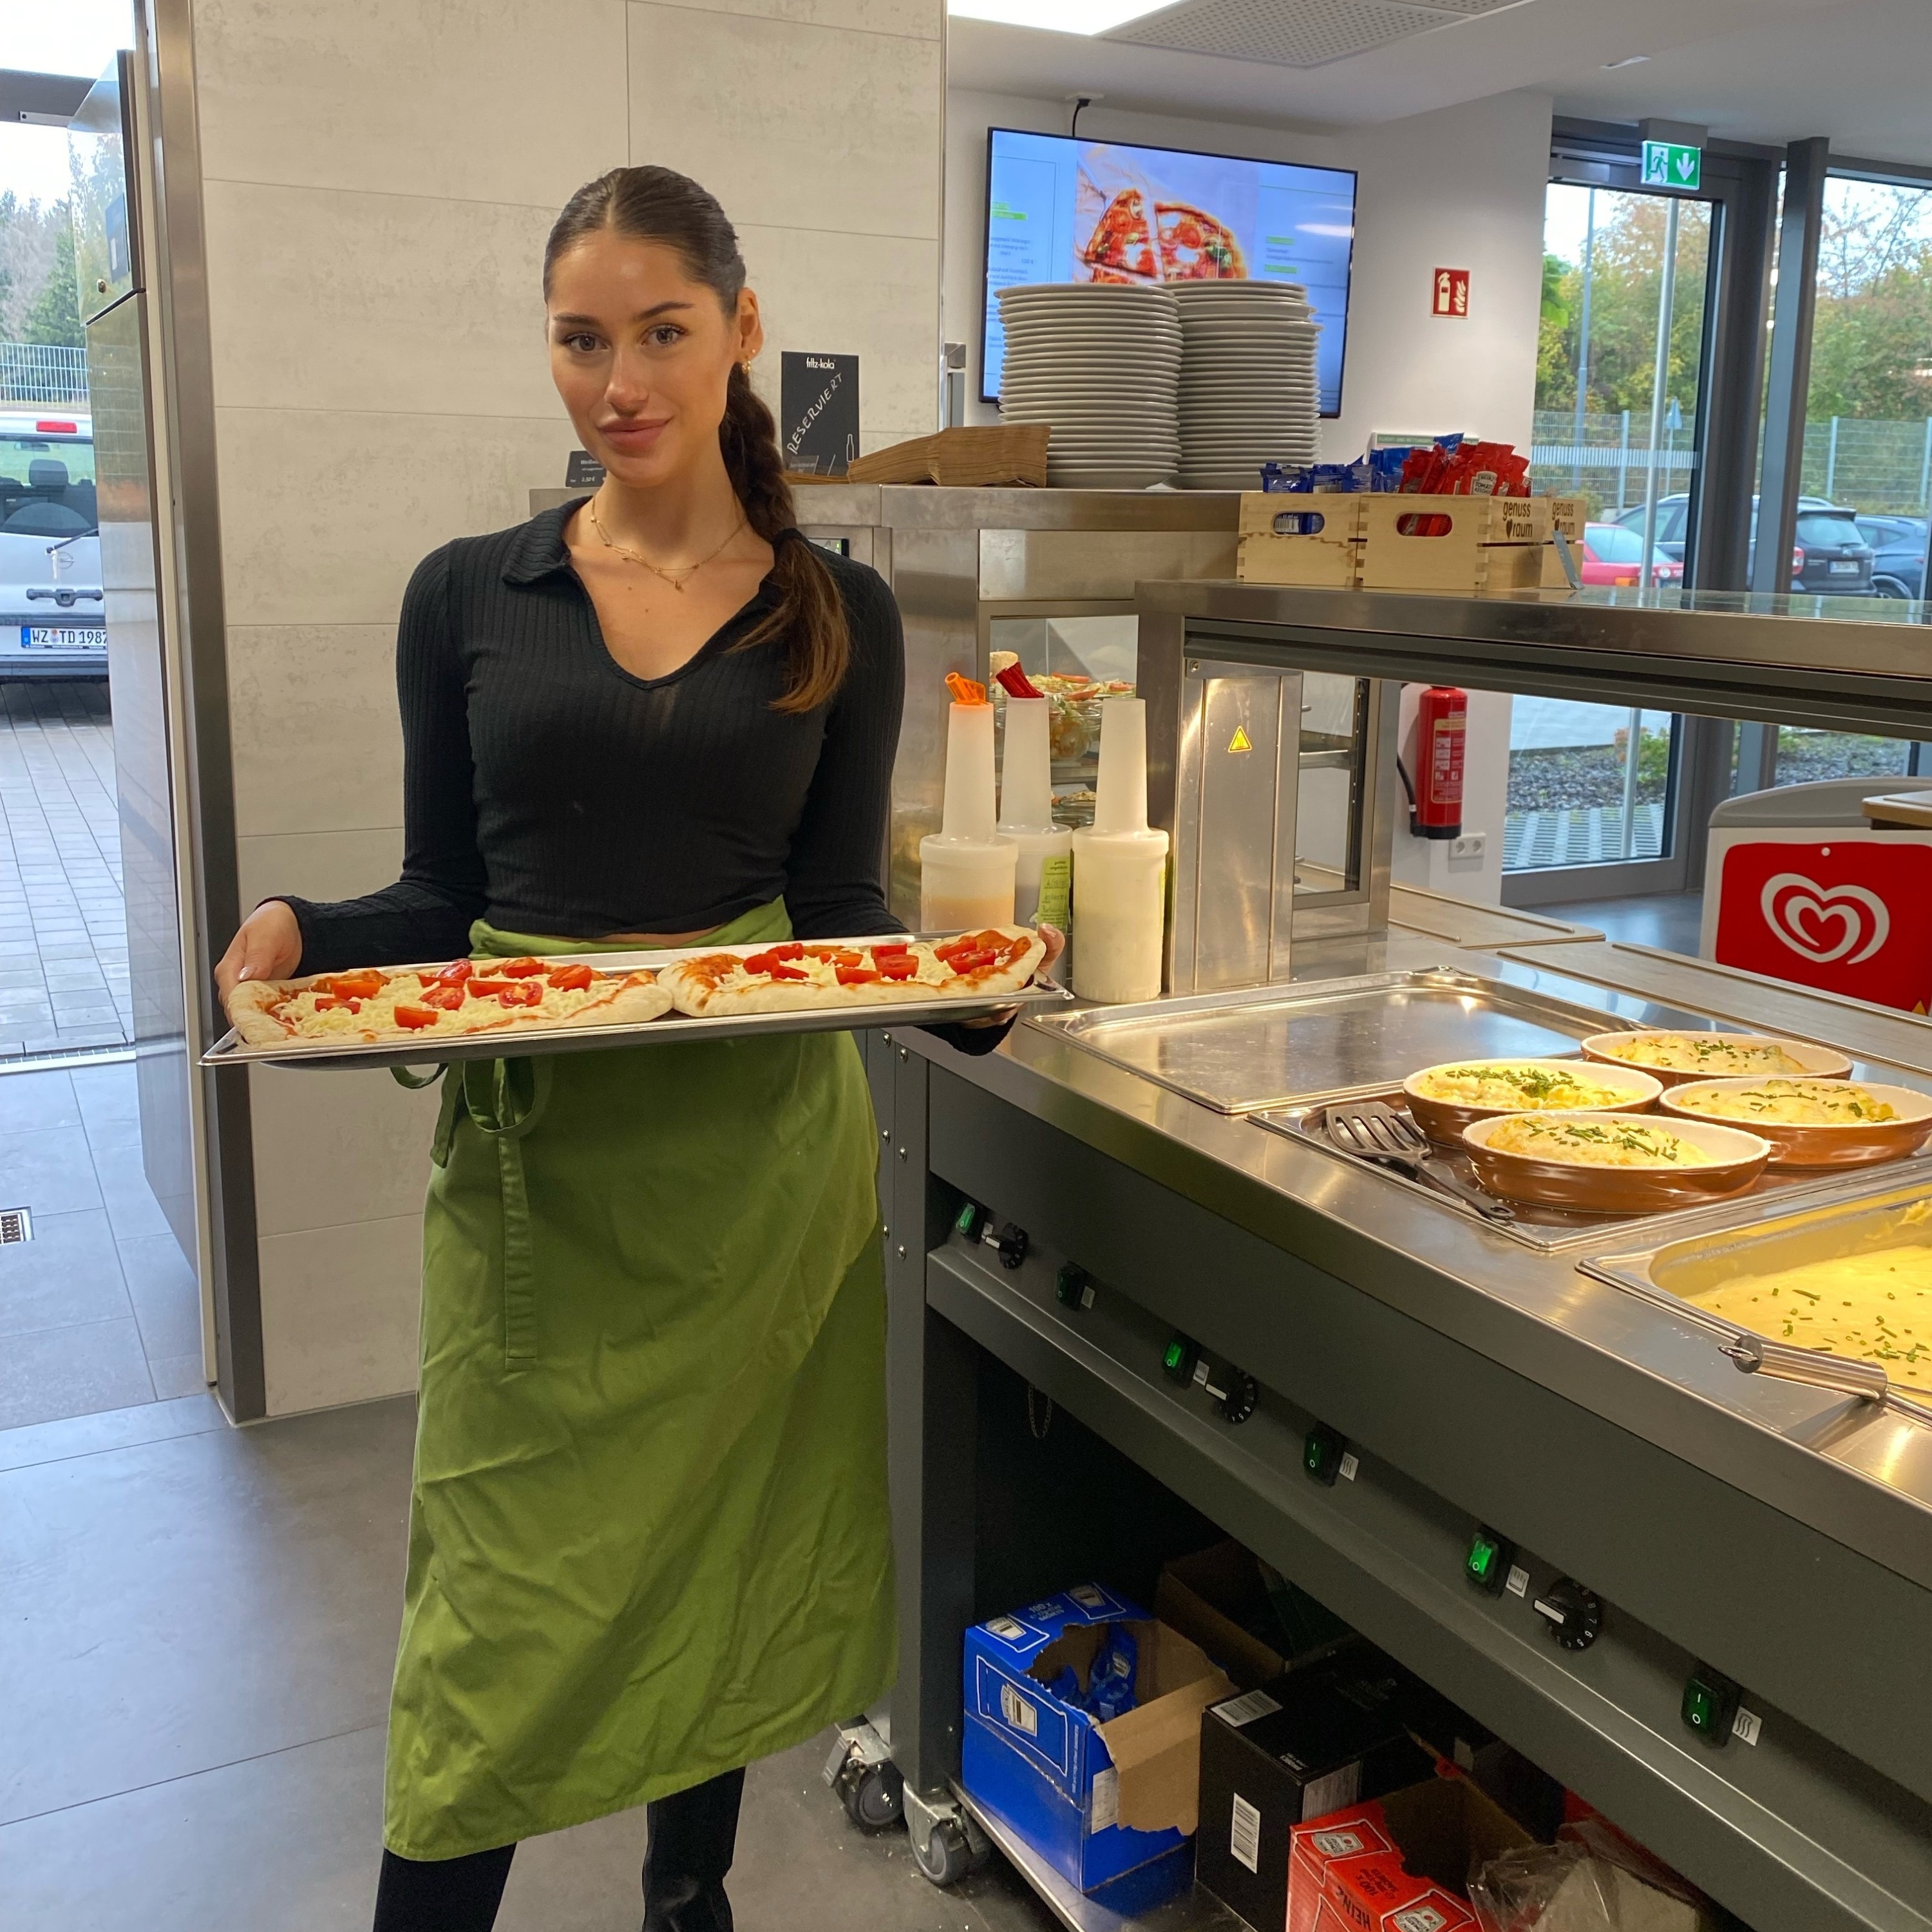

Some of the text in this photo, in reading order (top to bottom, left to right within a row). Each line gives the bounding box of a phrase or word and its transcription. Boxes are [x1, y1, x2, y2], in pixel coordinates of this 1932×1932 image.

[806, 357, 835, 369] fritz-kola
[787, 373, 842, 455] RESERVIERT
[1502, 502, 1531, 521] genuss
[1552, 502, 1573, 520] genuss
[1512, 522, 1533, 538] raum
[1560, 522, 1575, 535] raum
[32, 630, 48, 643] WZ
[59, 631, 75, 643] TD
